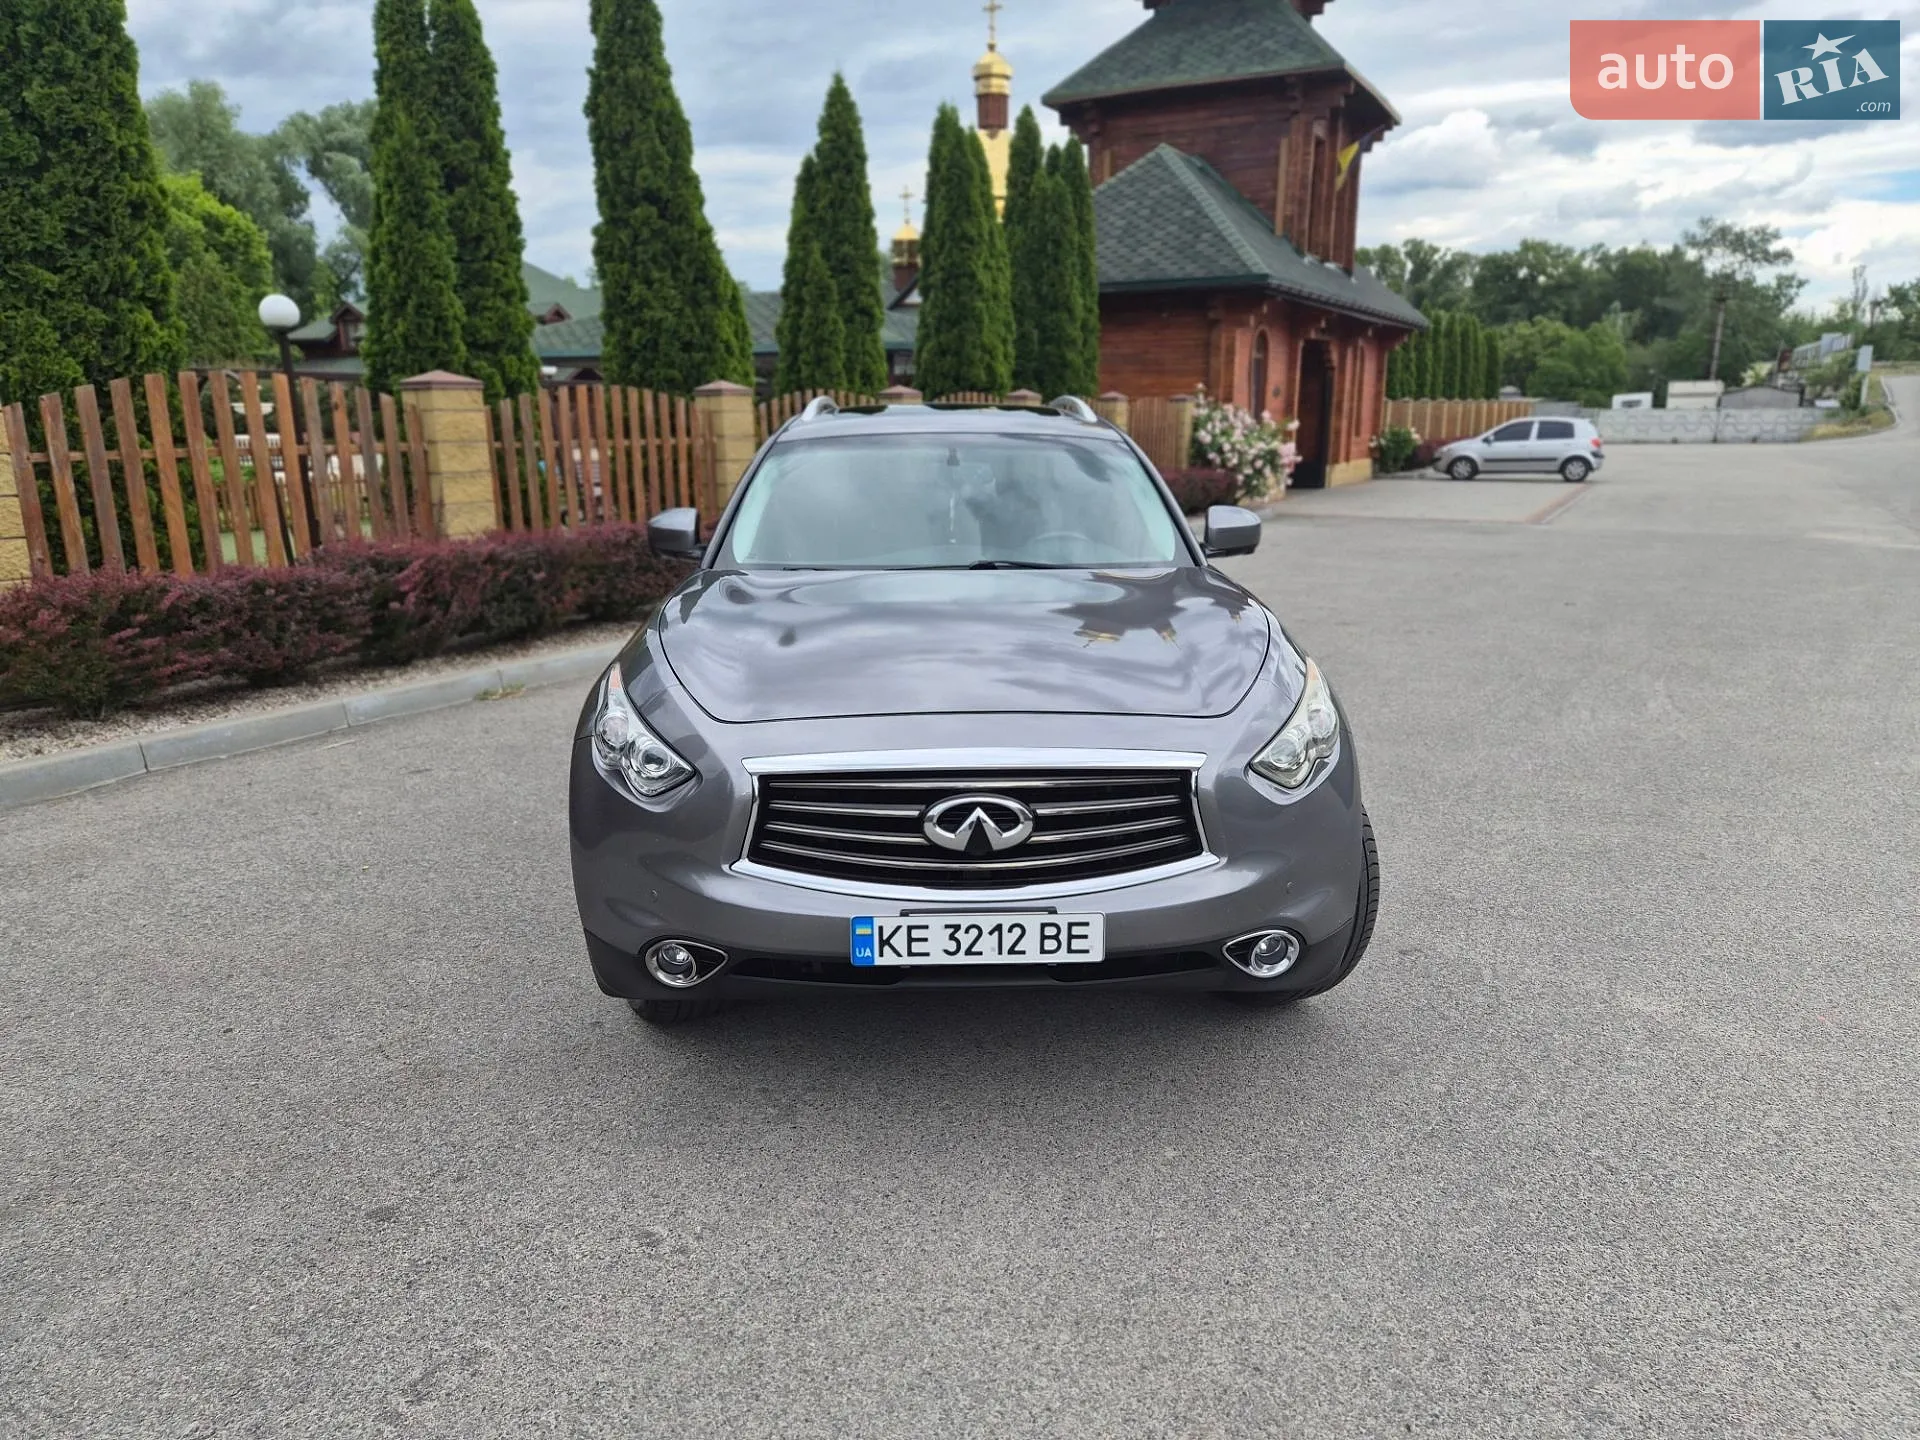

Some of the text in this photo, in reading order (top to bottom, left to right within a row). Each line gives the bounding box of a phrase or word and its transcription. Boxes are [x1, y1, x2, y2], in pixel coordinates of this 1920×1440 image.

[878, 921, 1090, 958] KE 3212 BE
[855, 946, 872, 958] UA
